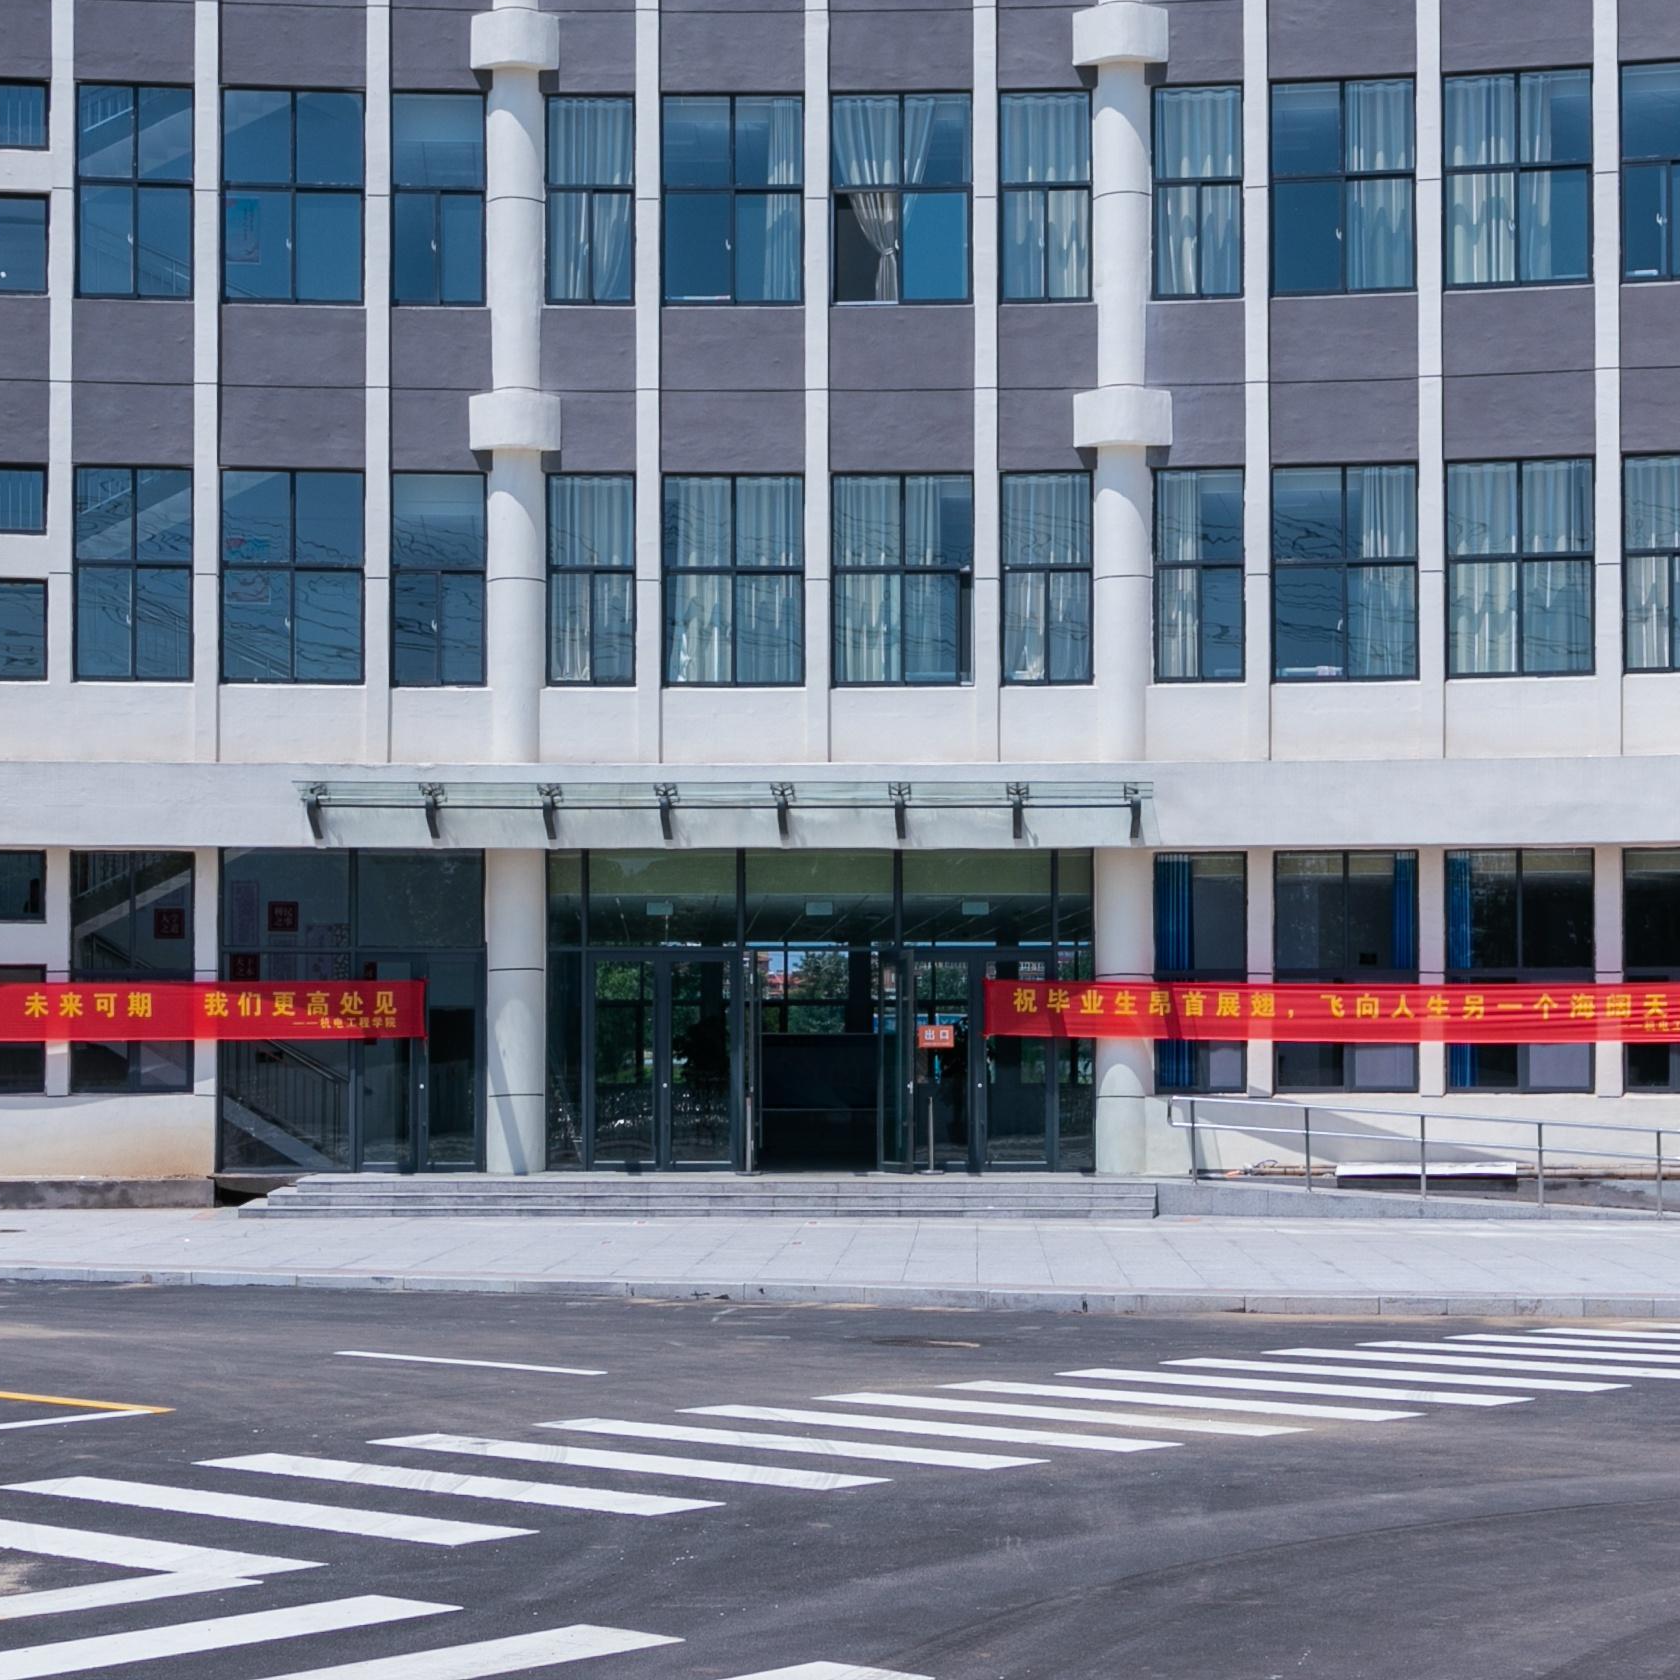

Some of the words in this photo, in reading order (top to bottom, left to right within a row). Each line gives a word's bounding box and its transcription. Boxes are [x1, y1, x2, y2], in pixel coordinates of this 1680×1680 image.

[24, 992, 153, 1018] 未来可期
[204, 991, 398, 1017] 我们更高处见
[924, 1028, 950, 1041] 出口
